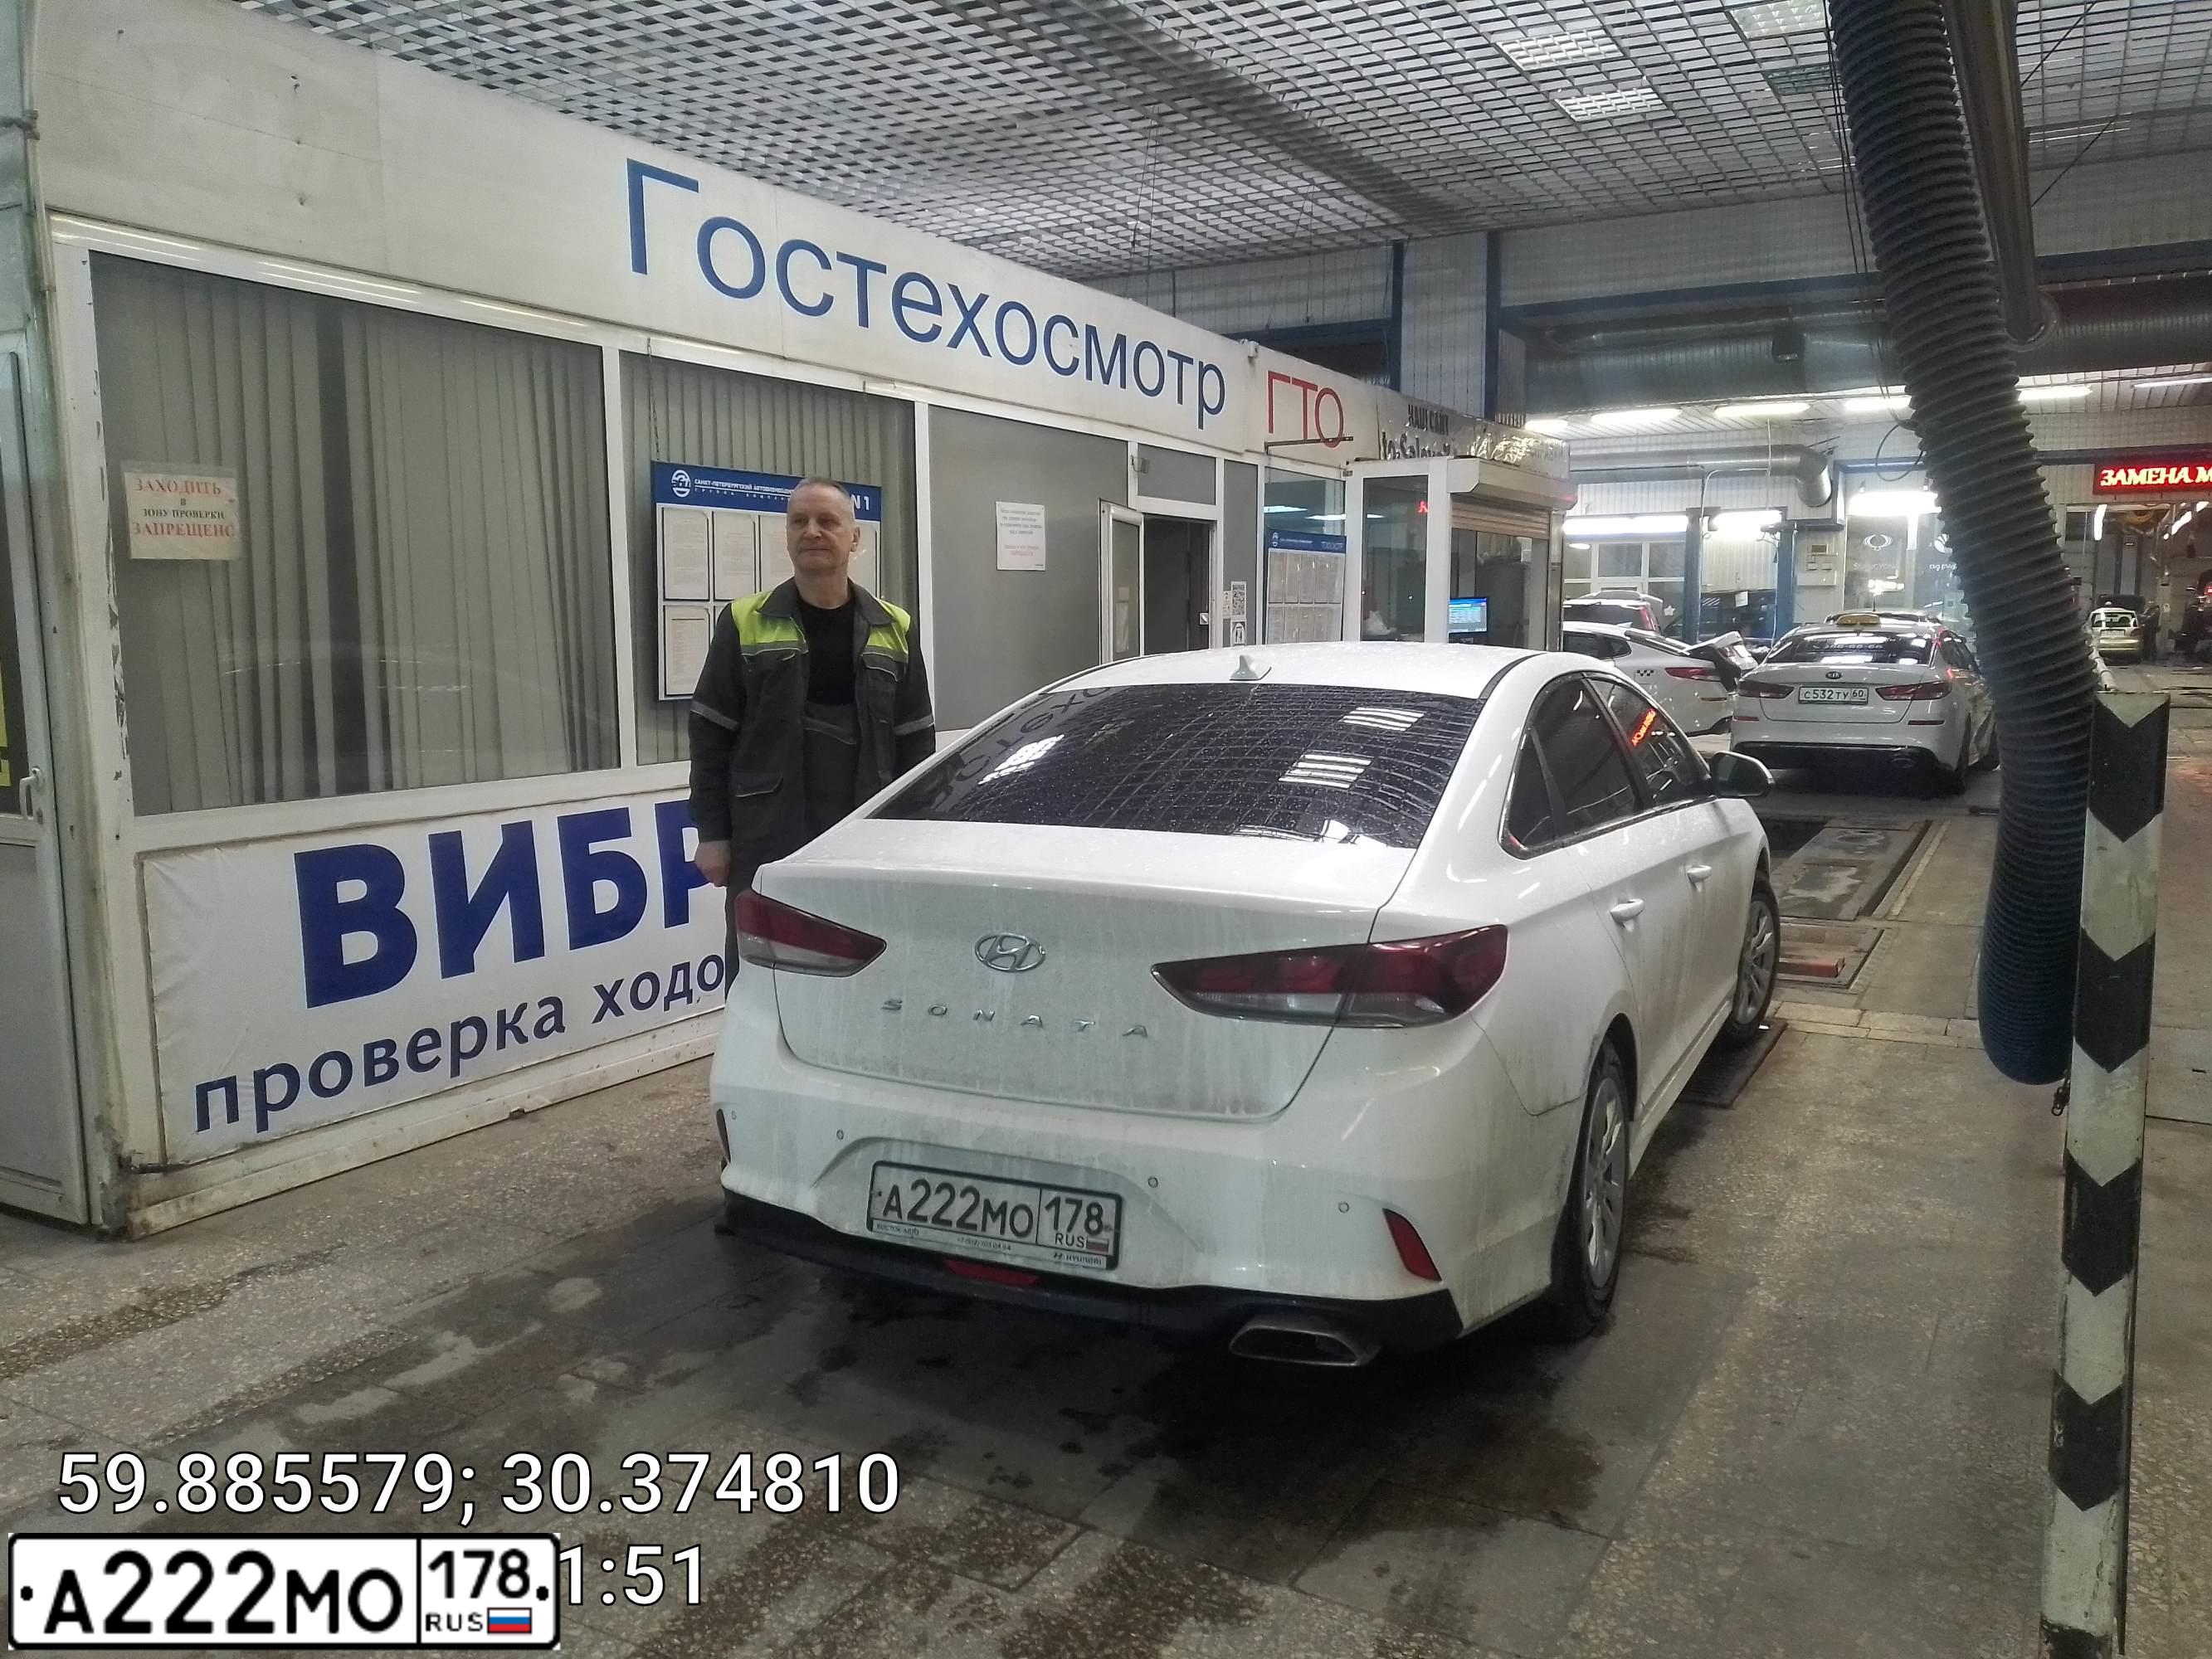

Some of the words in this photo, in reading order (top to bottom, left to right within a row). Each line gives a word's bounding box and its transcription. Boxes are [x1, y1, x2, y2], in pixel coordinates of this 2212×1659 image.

[626, 158, 1225, 429] Гостехосмотр
[1267, 370, 1344, 448] ГТО
[134, 478, 222, 494] ЗАХОДИТЬ
[2100, 466, 2194, 487] ЗАМЕНА
[141, 508, 168, 518] ЗОНУ
[172, 508, 225, 519] ПРОВЕРКИ
[295, 799, 715, 1009] ВИБР
[881, 998, 1148, 1038] SONATA
[195, 995, 565, 1133] проверка
[592, 953, 724, 1024] ходо
[882, 1179, 1034, 1238] А222МО
[1045, 1196, 1104, 1236] 178
[1055, 1233, 1085, 1248] RUS
